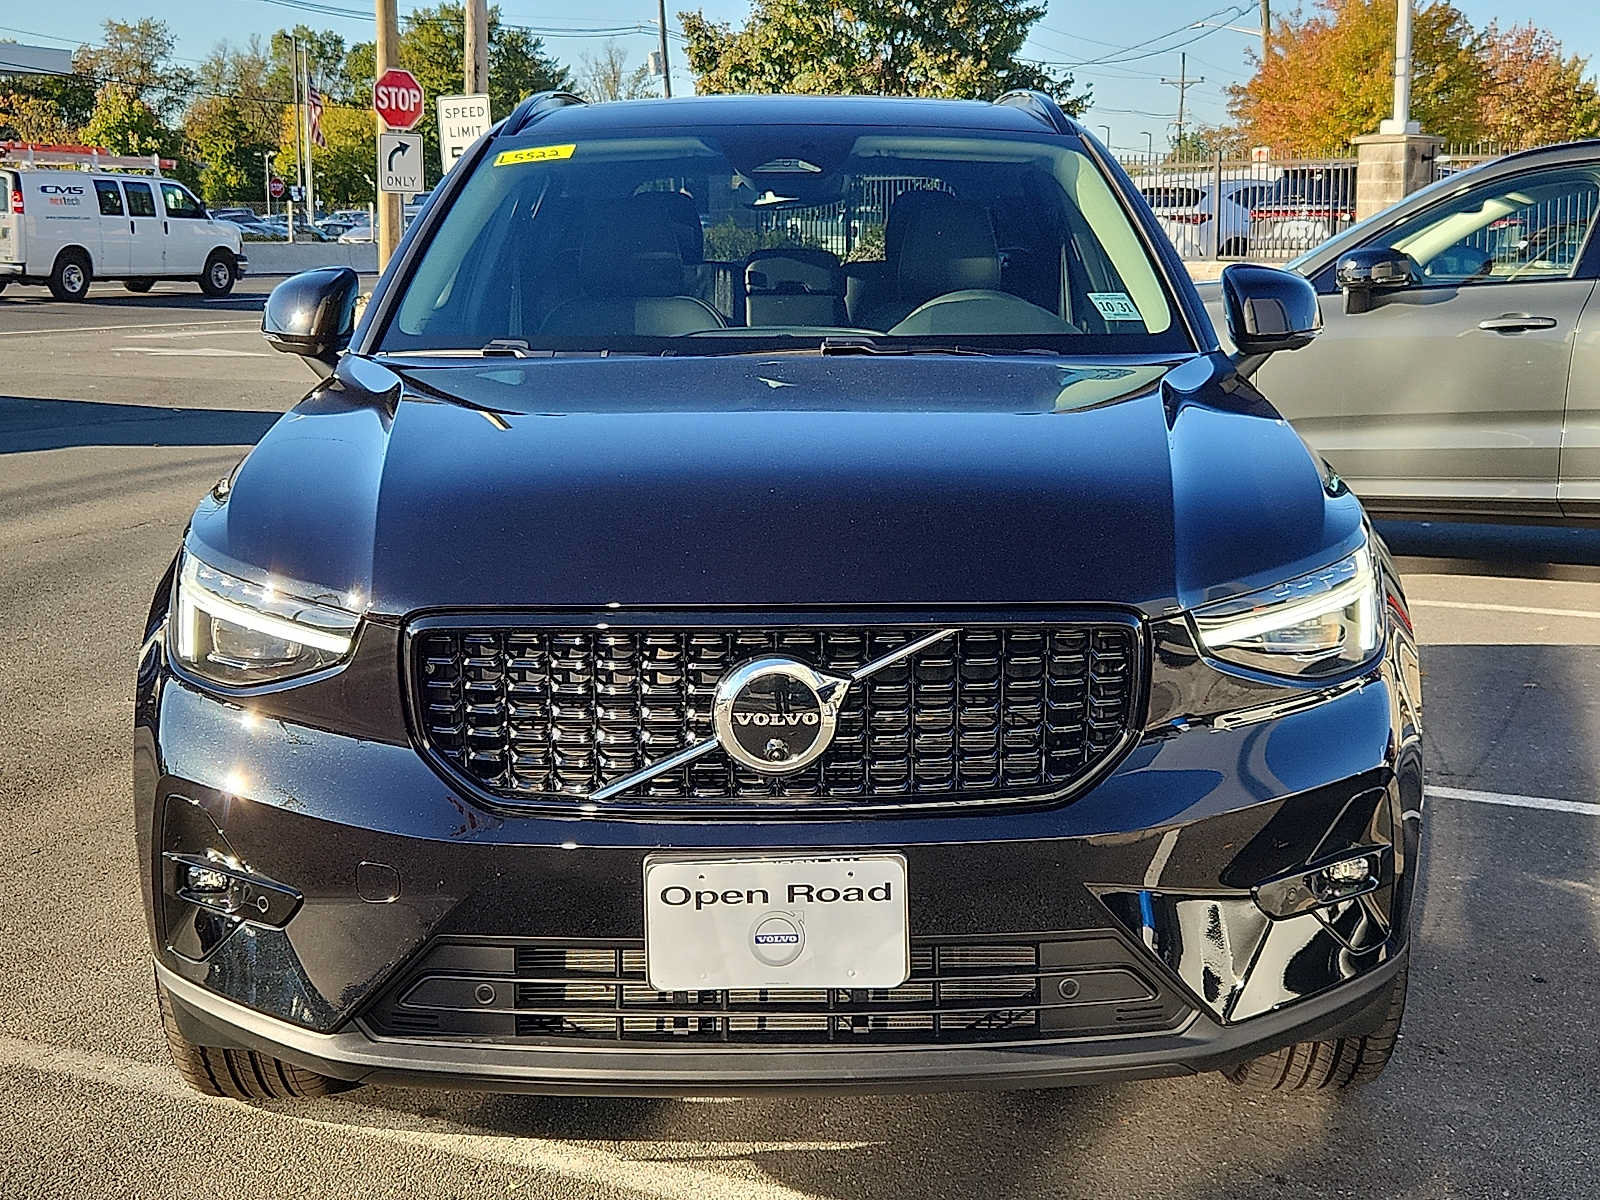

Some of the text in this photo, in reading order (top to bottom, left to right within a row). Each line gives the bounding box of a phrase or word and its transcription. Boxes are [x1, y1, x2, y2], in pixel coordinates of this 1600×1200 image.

[376, 86, 420, 112] STOP
[445, 106, 485, 119] SPEED
[449, 126, 482, 138] LIMIT
[386, 176, 417, 187] ONLY
[1098, 301, 1134, 313] 10 31
[733, 712, 819, 726] VOLVO
[660, 882, 892, 911] Open Road
[756, 935, 798, 943] VOLVO
